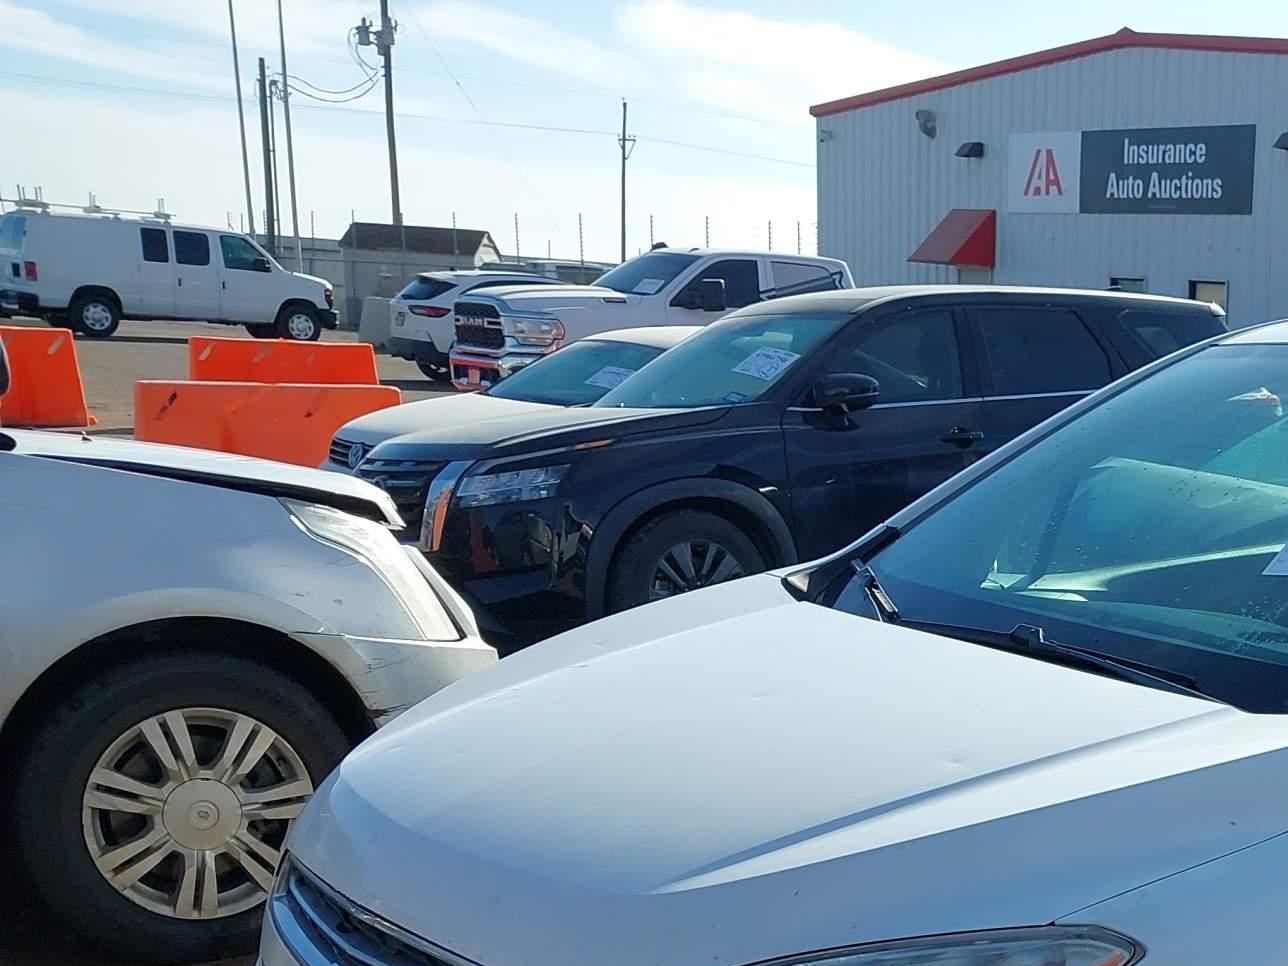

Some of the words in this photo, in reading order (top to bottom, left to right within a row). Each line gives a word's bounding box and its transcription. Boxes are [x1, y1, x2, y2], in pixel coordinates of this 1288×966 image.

[1123, 138, 1206, 165] Insurance
[1105, 173, 1144, 199] Auto
[1147, 171, 1223, 199] Auctions
